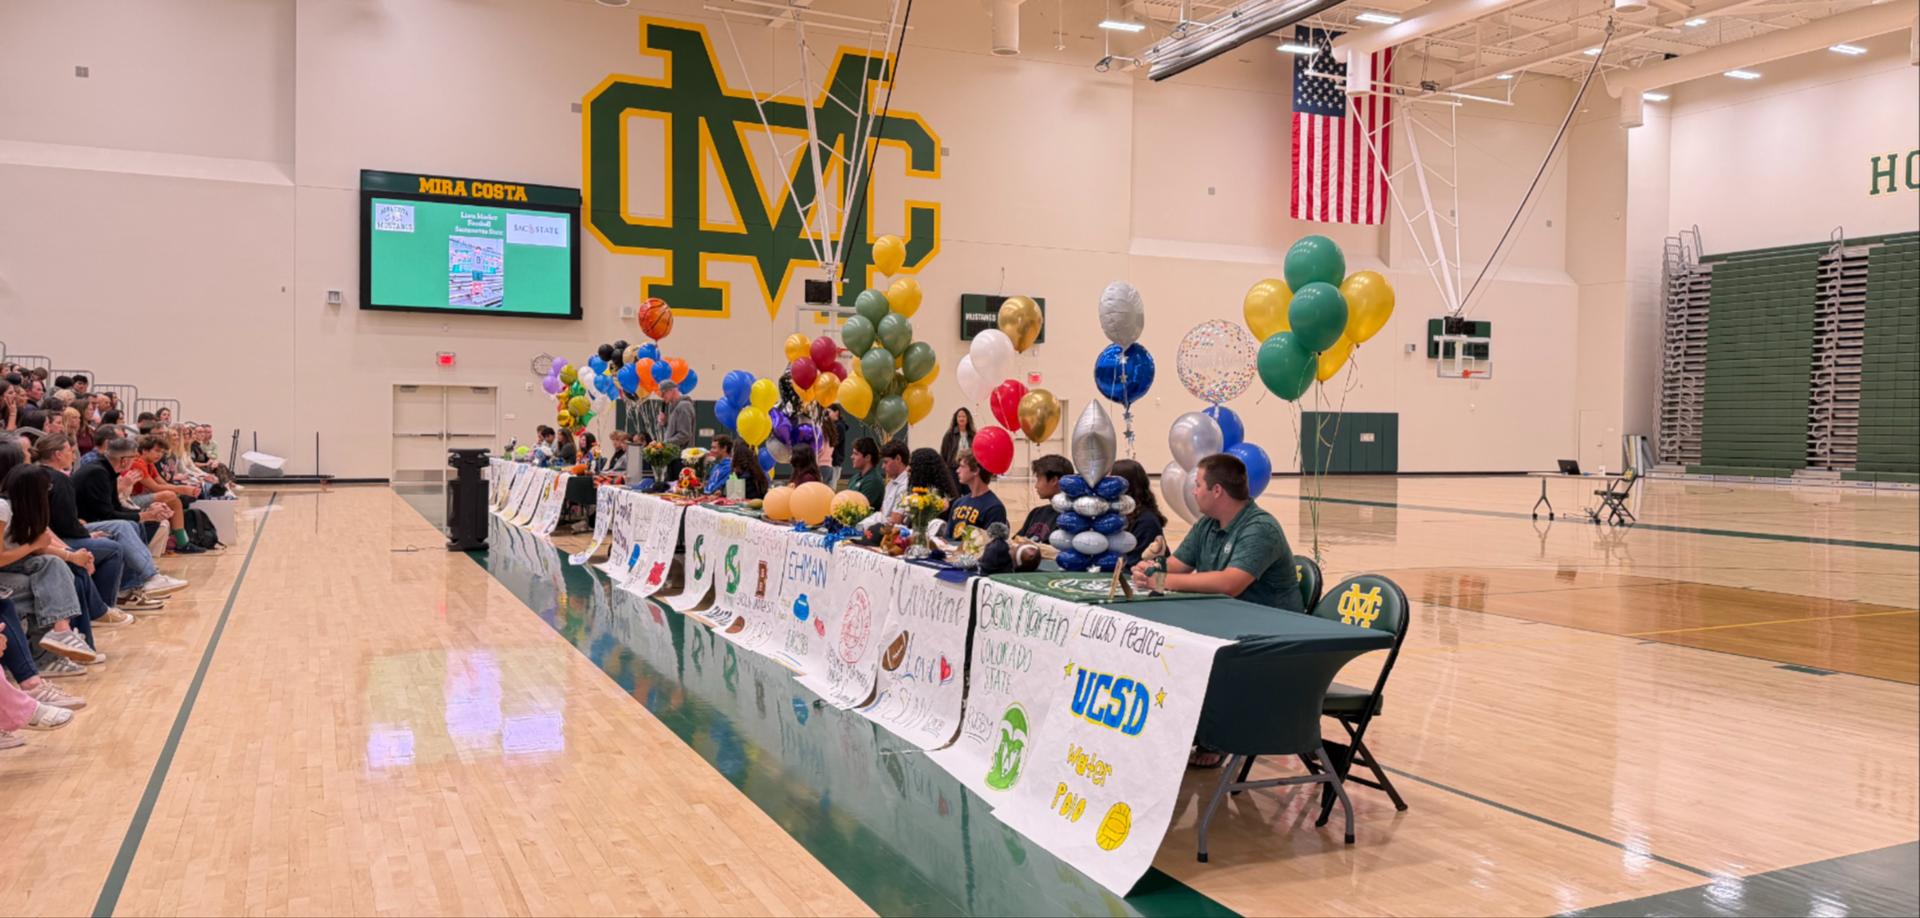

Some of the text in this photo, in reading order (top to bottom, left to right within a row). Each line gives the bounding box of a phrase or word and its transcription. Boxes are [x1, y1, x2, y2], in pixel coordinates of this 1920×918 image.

[419, 177, 528, 202] MIRA COSTA
[514, 224, 559, 235] SAC STATE
[965, 312, 997, 322] MUSTANGS
[788, 551, 828, 589] EHMAN
[980, 583, 1070, 647] Ben Martin
[1081, 608, 1166, 658] Lucas Pearce
[980, 637, 1032, 672] COLORADO
[984, 665, 1012, 695] STATE
[1070, 666, 1151, 737] UCSD
